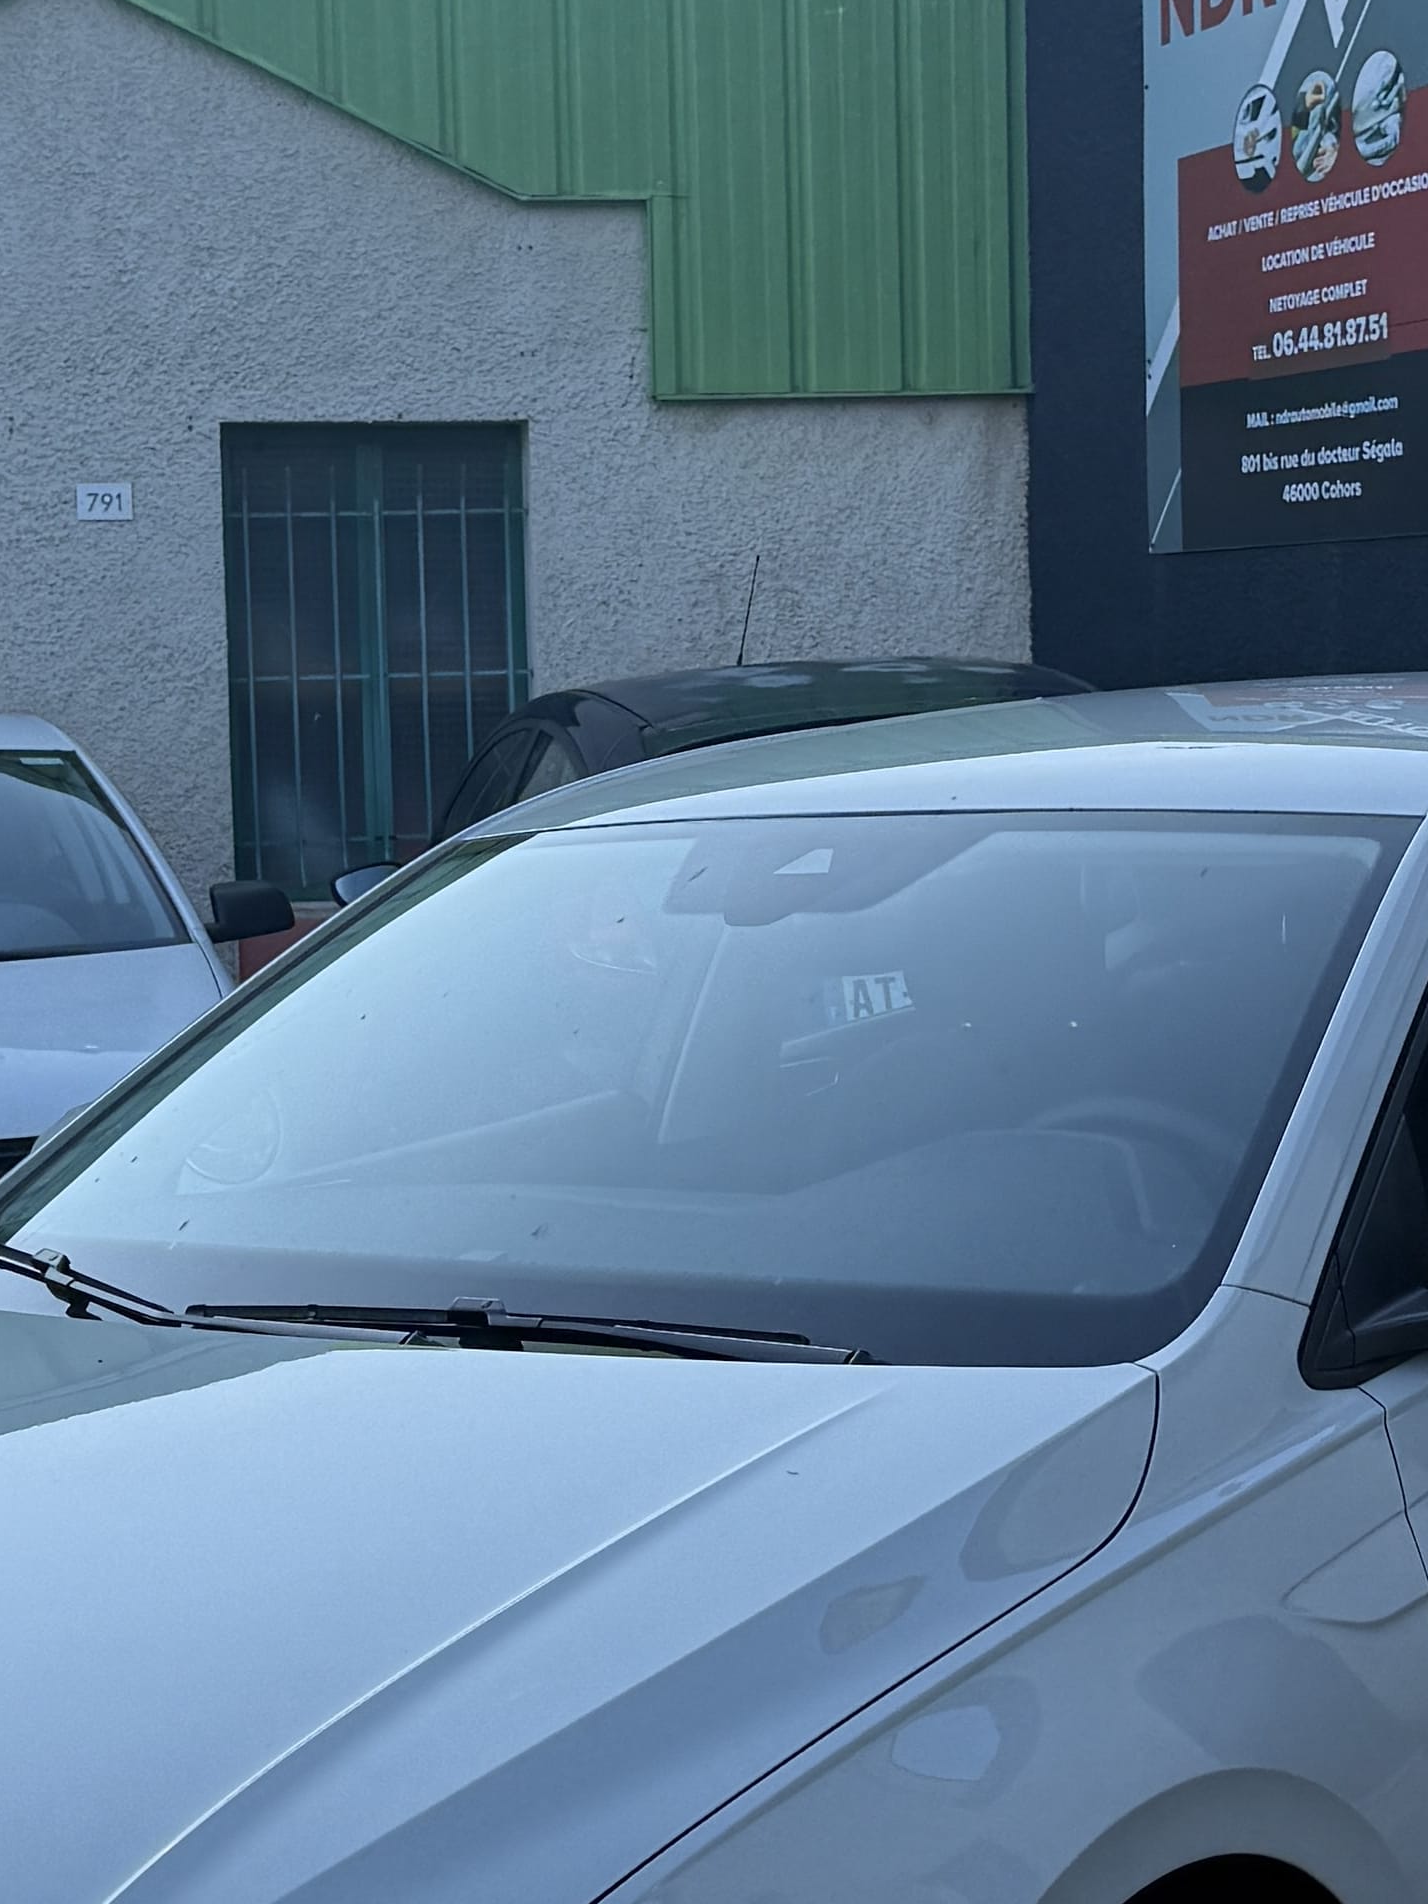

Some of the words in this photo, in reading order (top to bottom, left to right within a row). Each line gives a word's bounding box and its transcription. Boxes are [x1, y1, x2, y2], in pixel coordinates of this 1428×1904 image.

[1207, 220, 1237, 241] ACHAT
[1243, 211, 1274, 233] VENTE
[1280, 200, 1321, 224] REPRISE
[1321, 187, 1370, 214] VÉHICULE
[1261, 249, 1310, 272] LOCATION
[1310, 243, 1324, 260] DE
[1326, 232, 1376, 258] VÉHICULE
[1321, 279, 1368, 304] COMPLET
[1272, 312, 1388, 357] 06.44.81.87.51
[1246, 413, 1269, 429] MAIL
[1241, 453, 1261, 473] 801
[1262, 453, 1279, 470] bis
[1280, 454, 1299, 470] rue
[1300, 449, 1316, 466] du
[1317, 445, 1360, 465] docteur
[1362, 438, 1404, 464] Ségala
[86, 492, 122, 512] 791
[1282, 482, 1320, 503] 46000
[1321, 480, 1362, 500] Cahors
